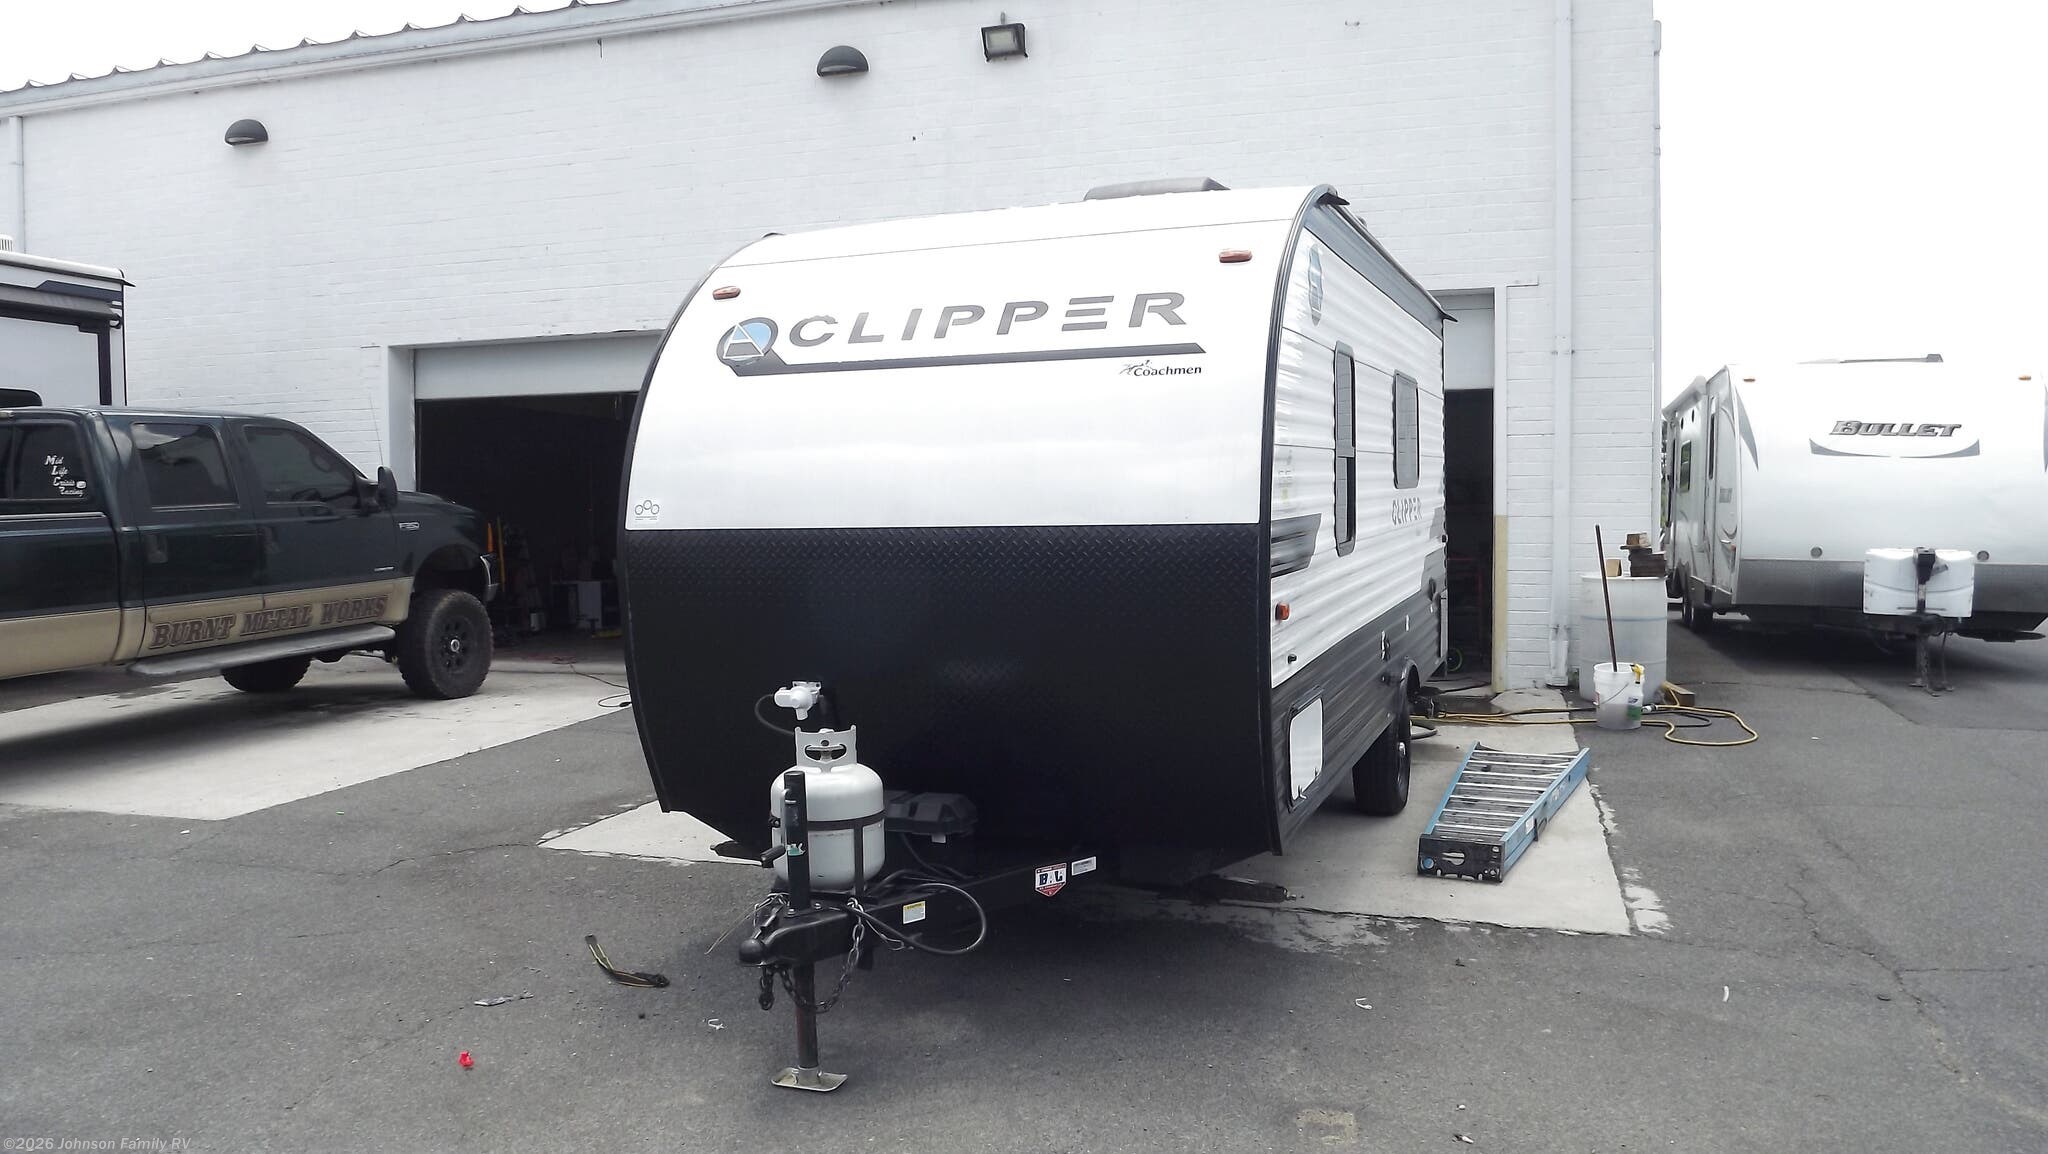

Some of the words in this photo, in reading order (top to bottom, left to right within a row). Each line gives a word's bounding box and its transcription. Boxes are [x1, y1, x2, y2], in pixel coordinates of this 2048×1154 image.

[789, 292, 1186, 347] CLIPPER
[1133, 366, 1202, 377] Coachmen
[1829, 420, 1962, 437] BULLET
[44, 455, 64, 465] Mid
[1391, 497, 1422, 525] CLIPPER
[149, 615, 236, 650] BURNT
[240, 605, 313, 636] METAL
[320, 596, 389, 625] WORKS
